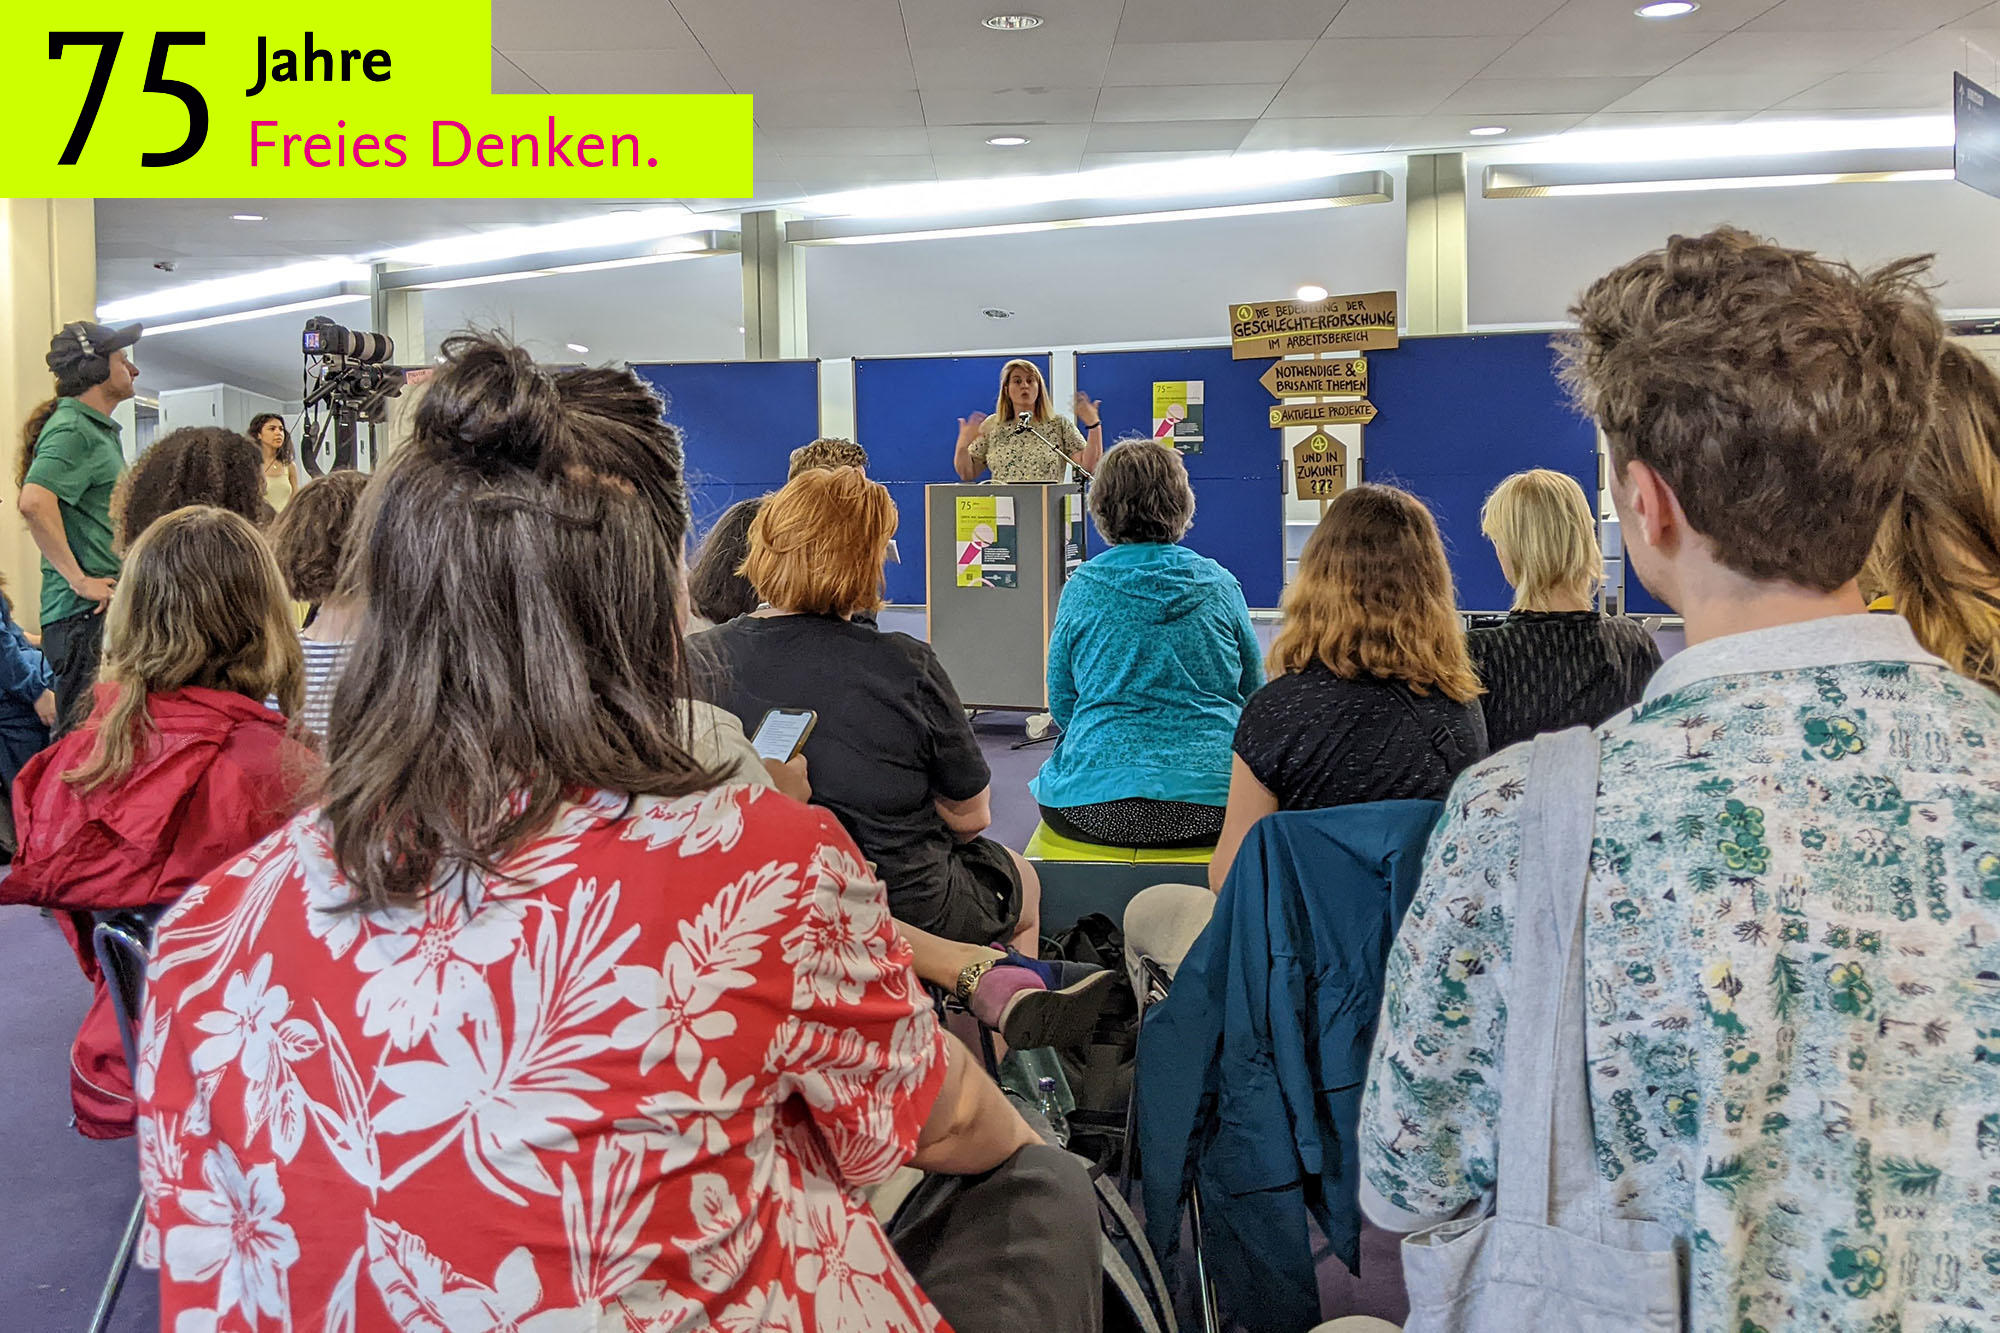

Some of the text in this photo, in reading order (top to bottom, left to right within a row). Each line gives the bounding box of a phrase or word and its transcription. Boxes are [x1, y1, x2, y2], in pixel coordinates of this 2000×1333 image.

[1255, 308, 1269, 319] DIE
[1345, 299, 1367, 311] DER
[1234, 311, 1395, 337] GESCHLECHTERFORSCHUNG
[1269, 331, 1369, 350] IM ARBEITSBEREICH
[1275, 364, 1342, 378] NOTWENDIGE
[1345, 363, 1356, 377] &
[1156, 385, 1166, 393] 75
[1276, 377, 1367, 392] BRISANTE THEMEN
[1281, 408, 1325, 421] AKTUELLE
[1328, 404, 1372, 416] PROJEKTE
[1301, 451, 1338, 464] UND IN
[1296, 464, 1344, 479] ZUKUNFT
[960, 501, 972, 510] 75
